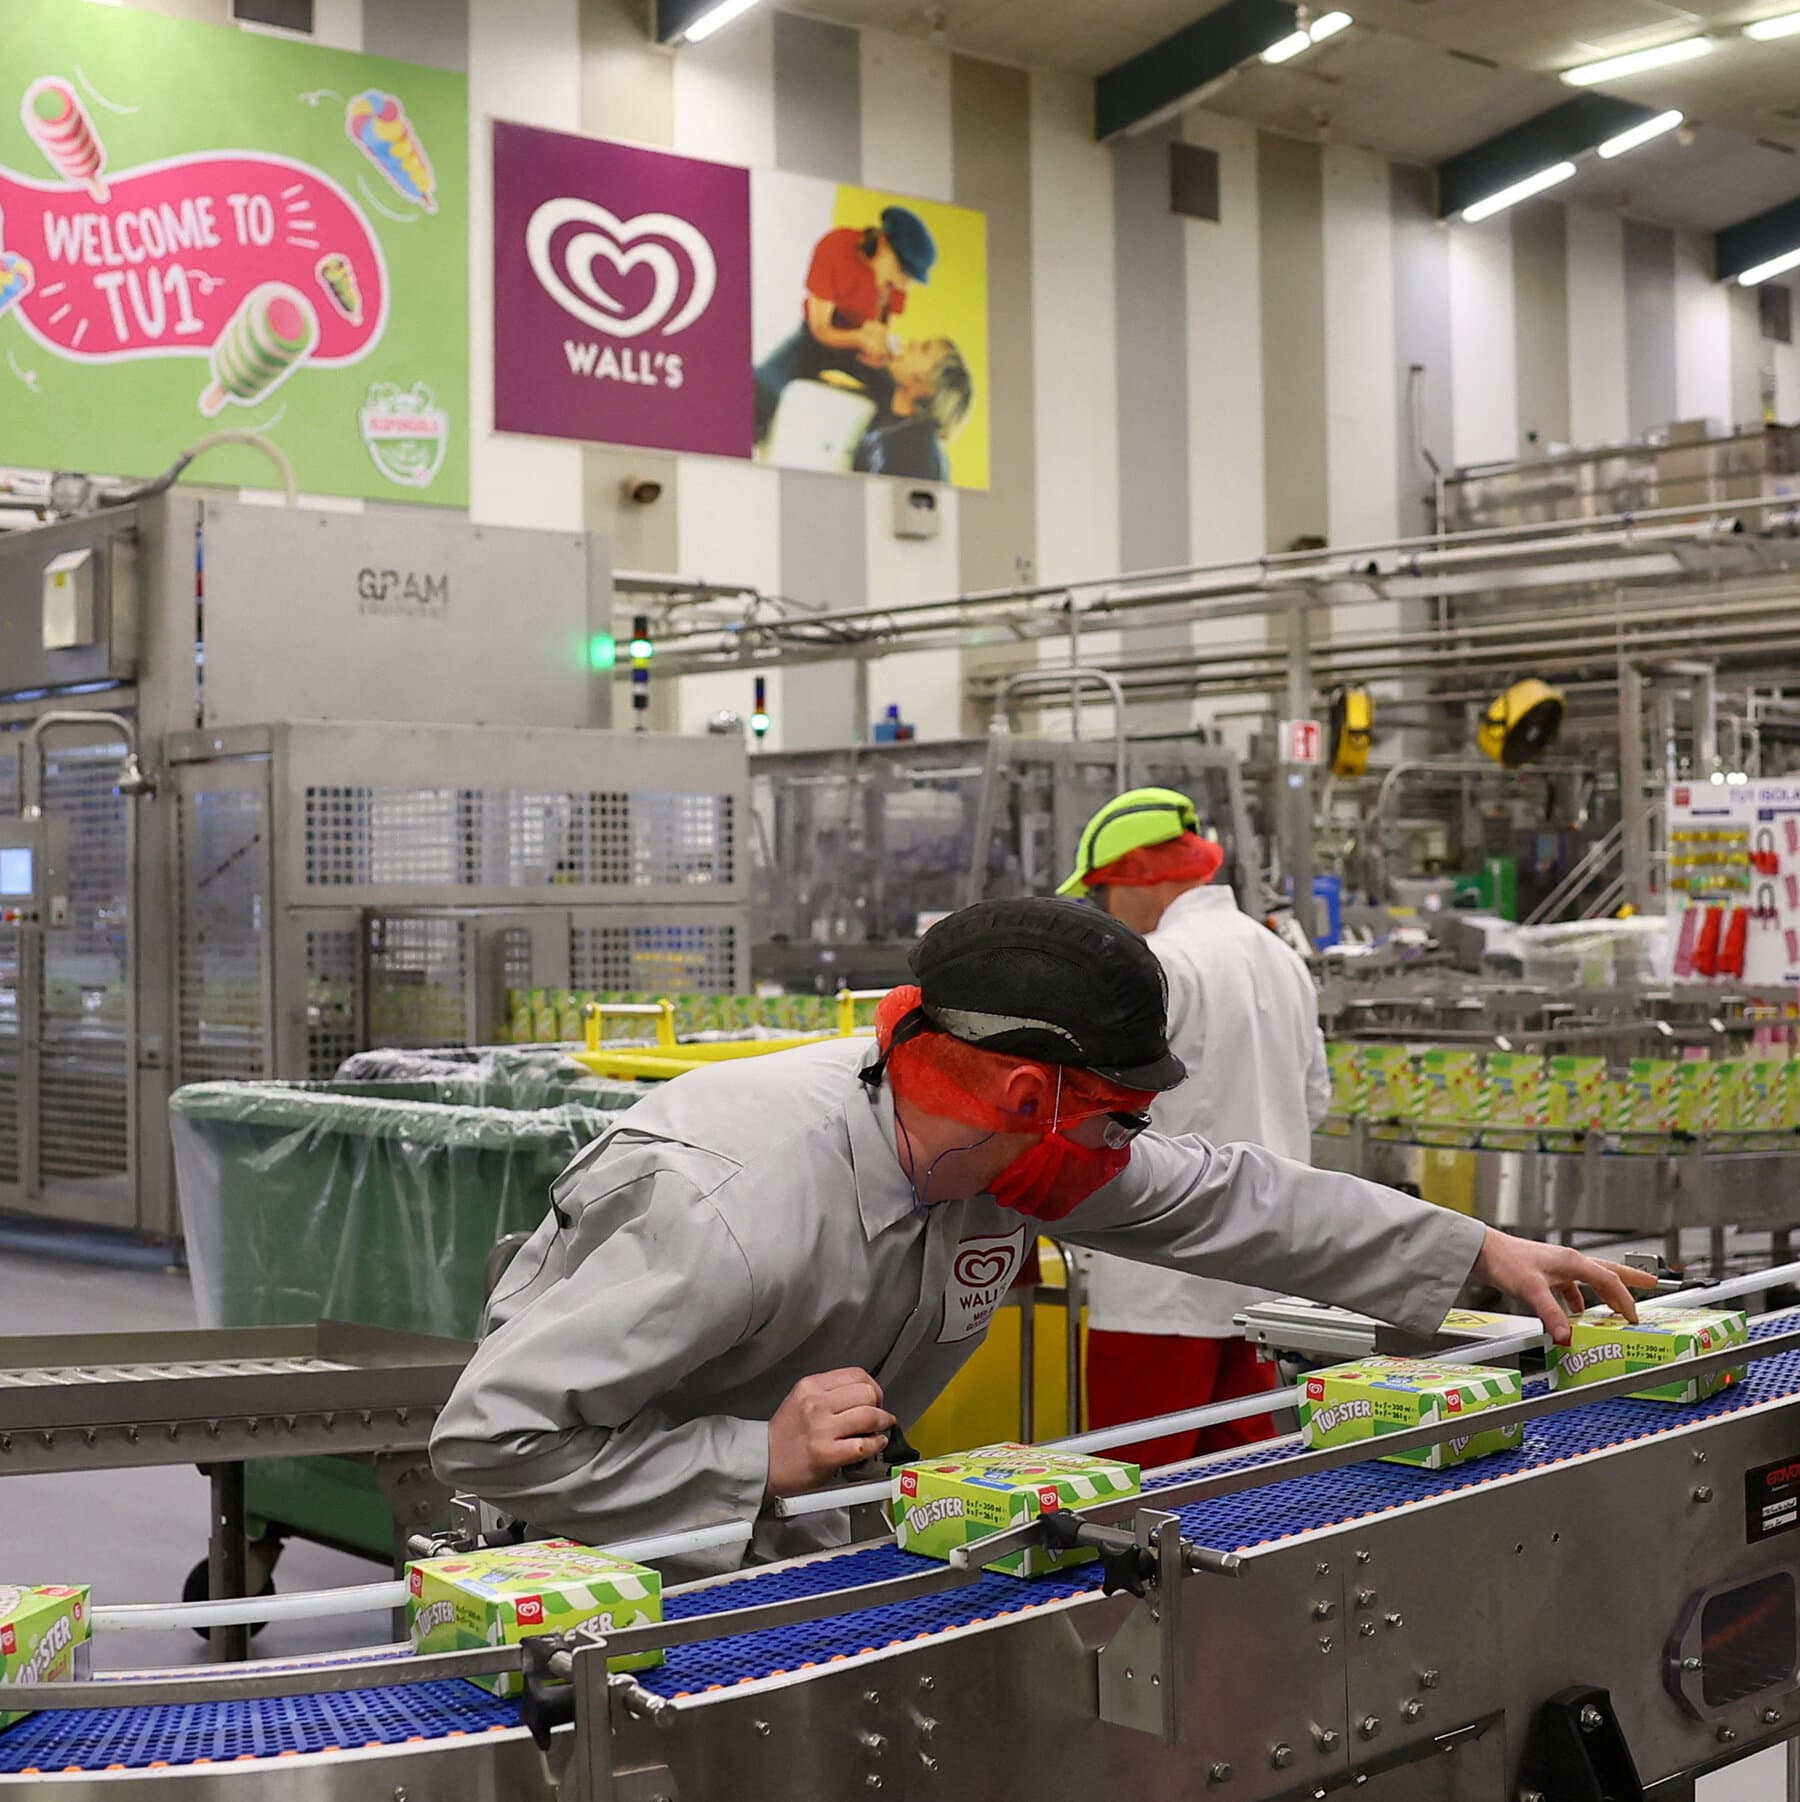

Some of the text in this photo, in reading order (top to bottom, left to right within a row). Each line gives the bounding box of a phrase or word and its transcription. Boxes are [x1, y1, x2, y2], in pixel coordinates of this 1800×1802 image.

[43, 194, 275, 265] WELCOME TO
[93, 265, 203, 342] TU1
[563, 340, 683, 389] WALL'S
